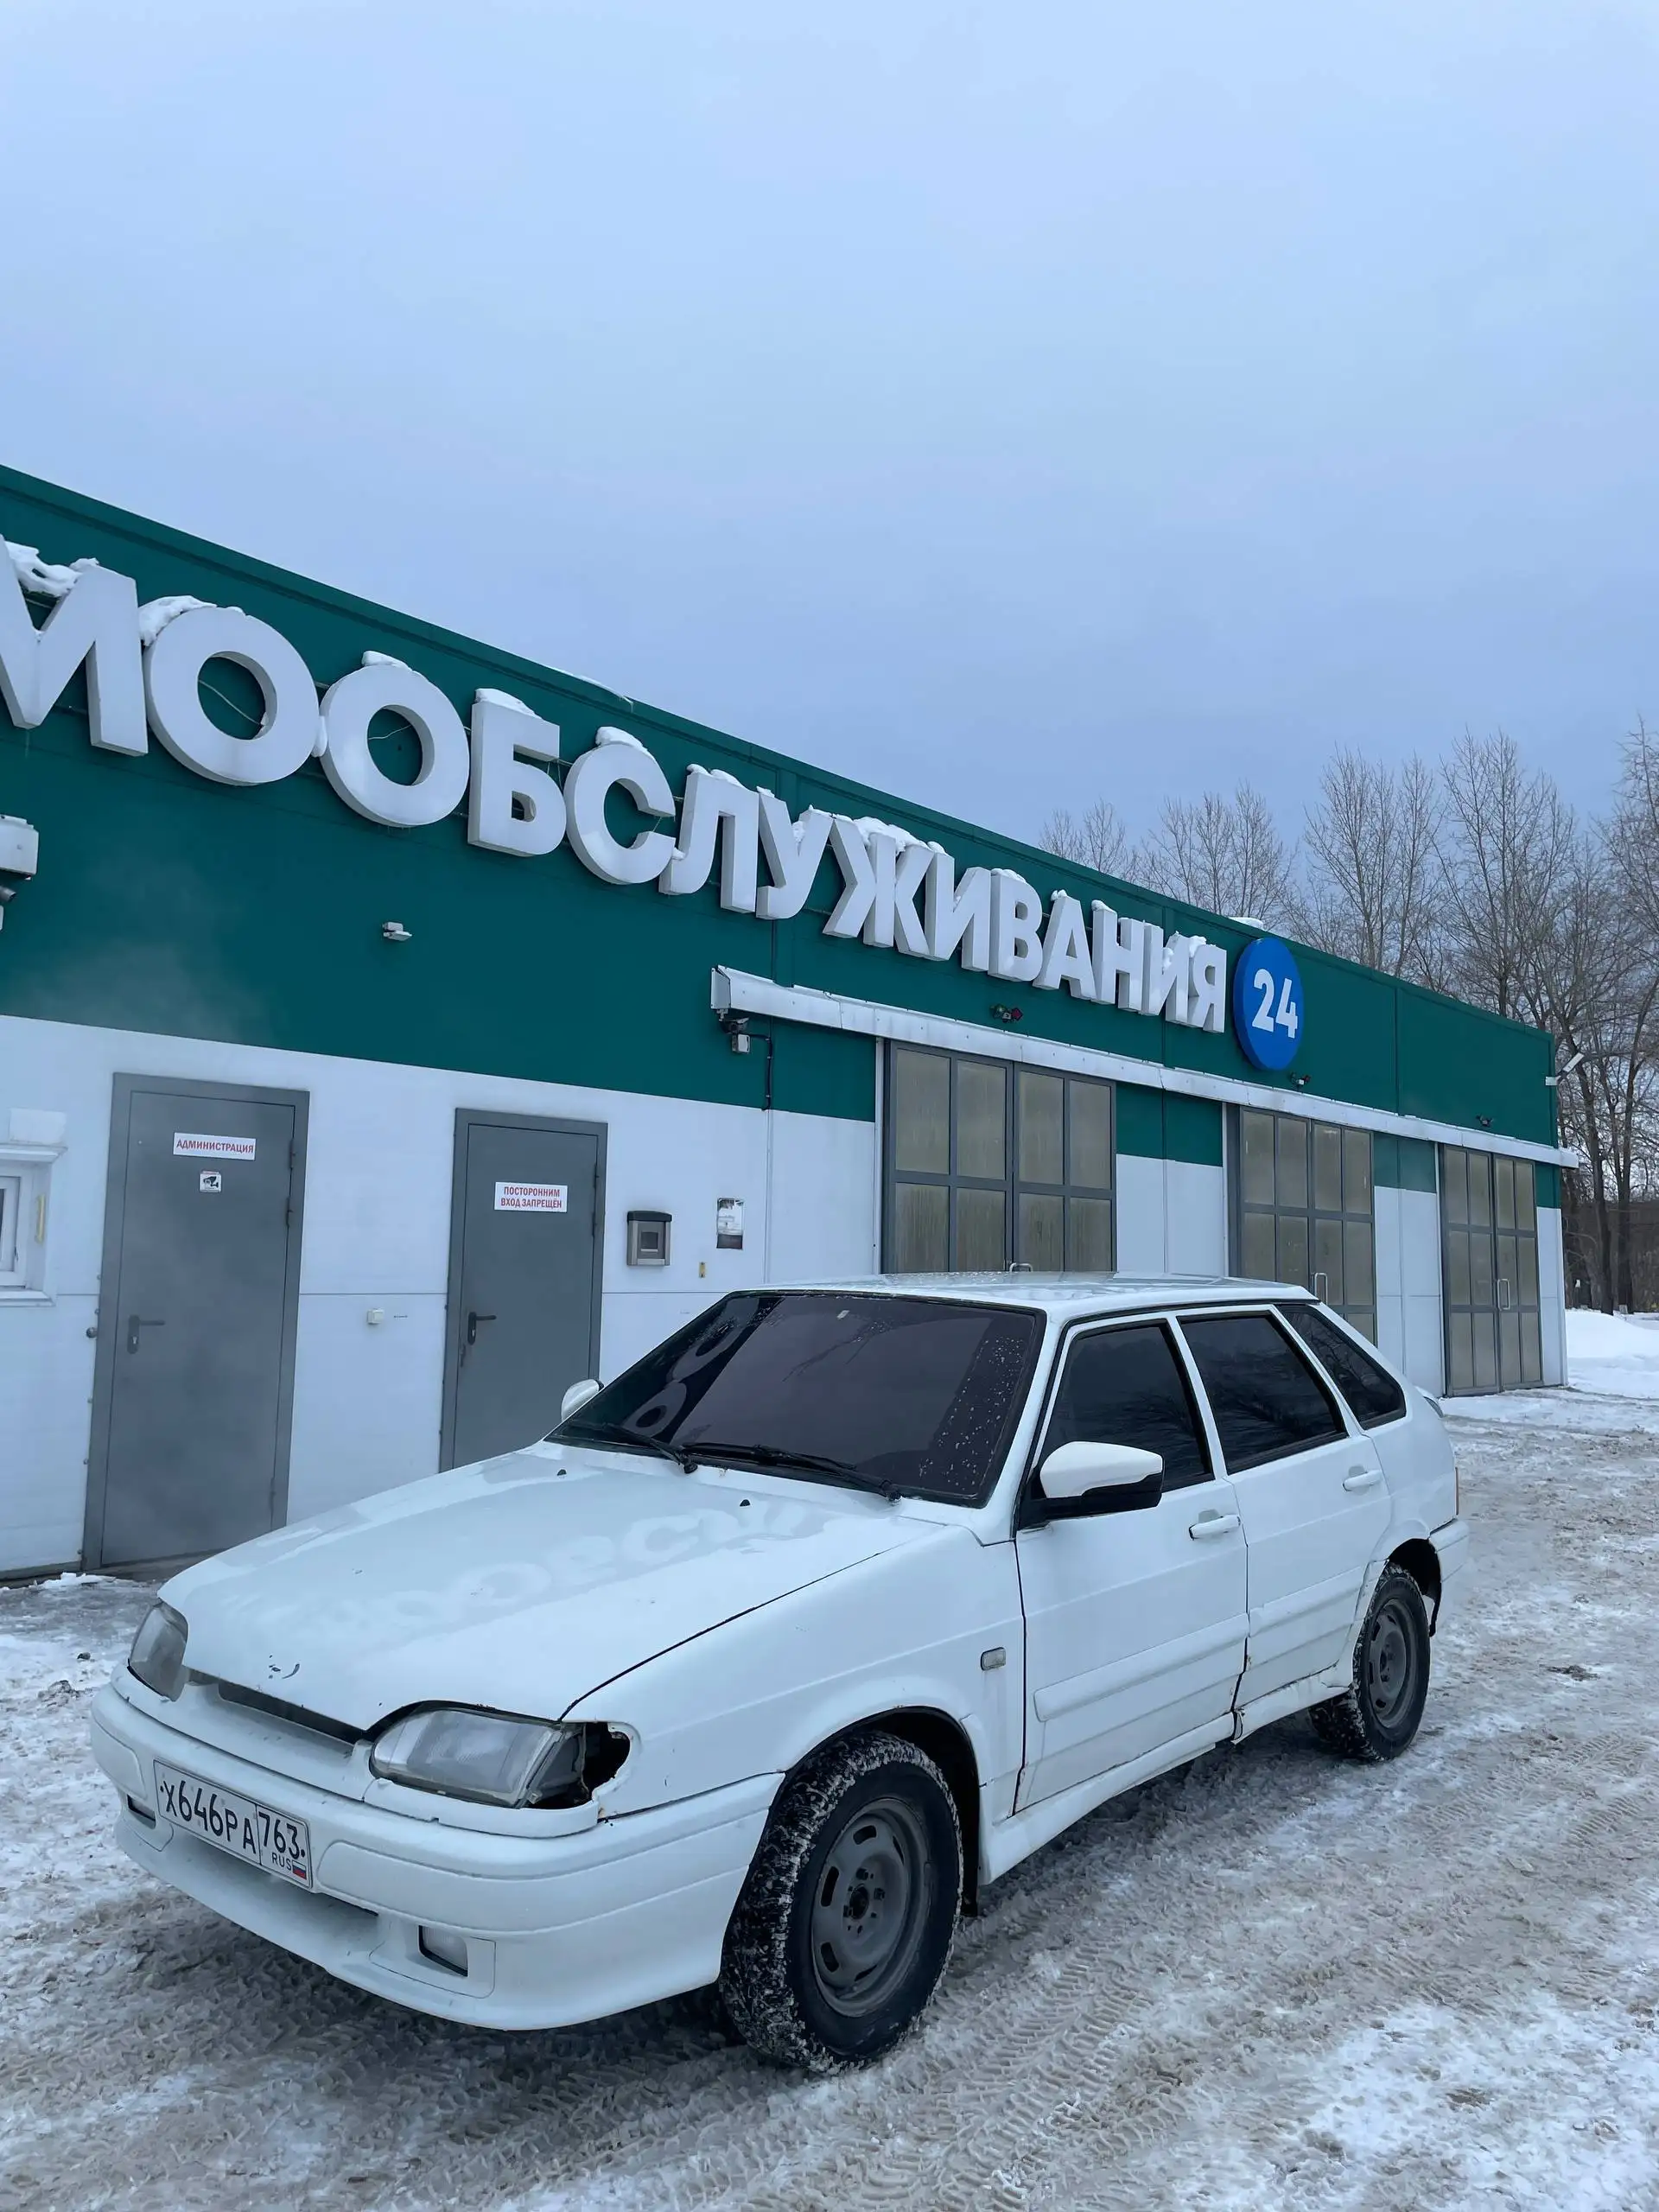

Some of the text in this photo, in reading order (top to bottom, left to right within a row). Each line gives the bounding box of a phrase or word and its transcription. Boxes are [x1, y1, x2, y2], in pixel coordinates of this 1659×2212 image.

[1252, 969, 1298, 1039] 24
[176, 1139, 254, 1154] АДМИНИСТРАЦИЯ
[504, 1186, 560, 1198] ПОСТОРОННИМ
[501, 1198, 520, 1208] ВХОД
[271, 1852, 292, 1871] RUS
